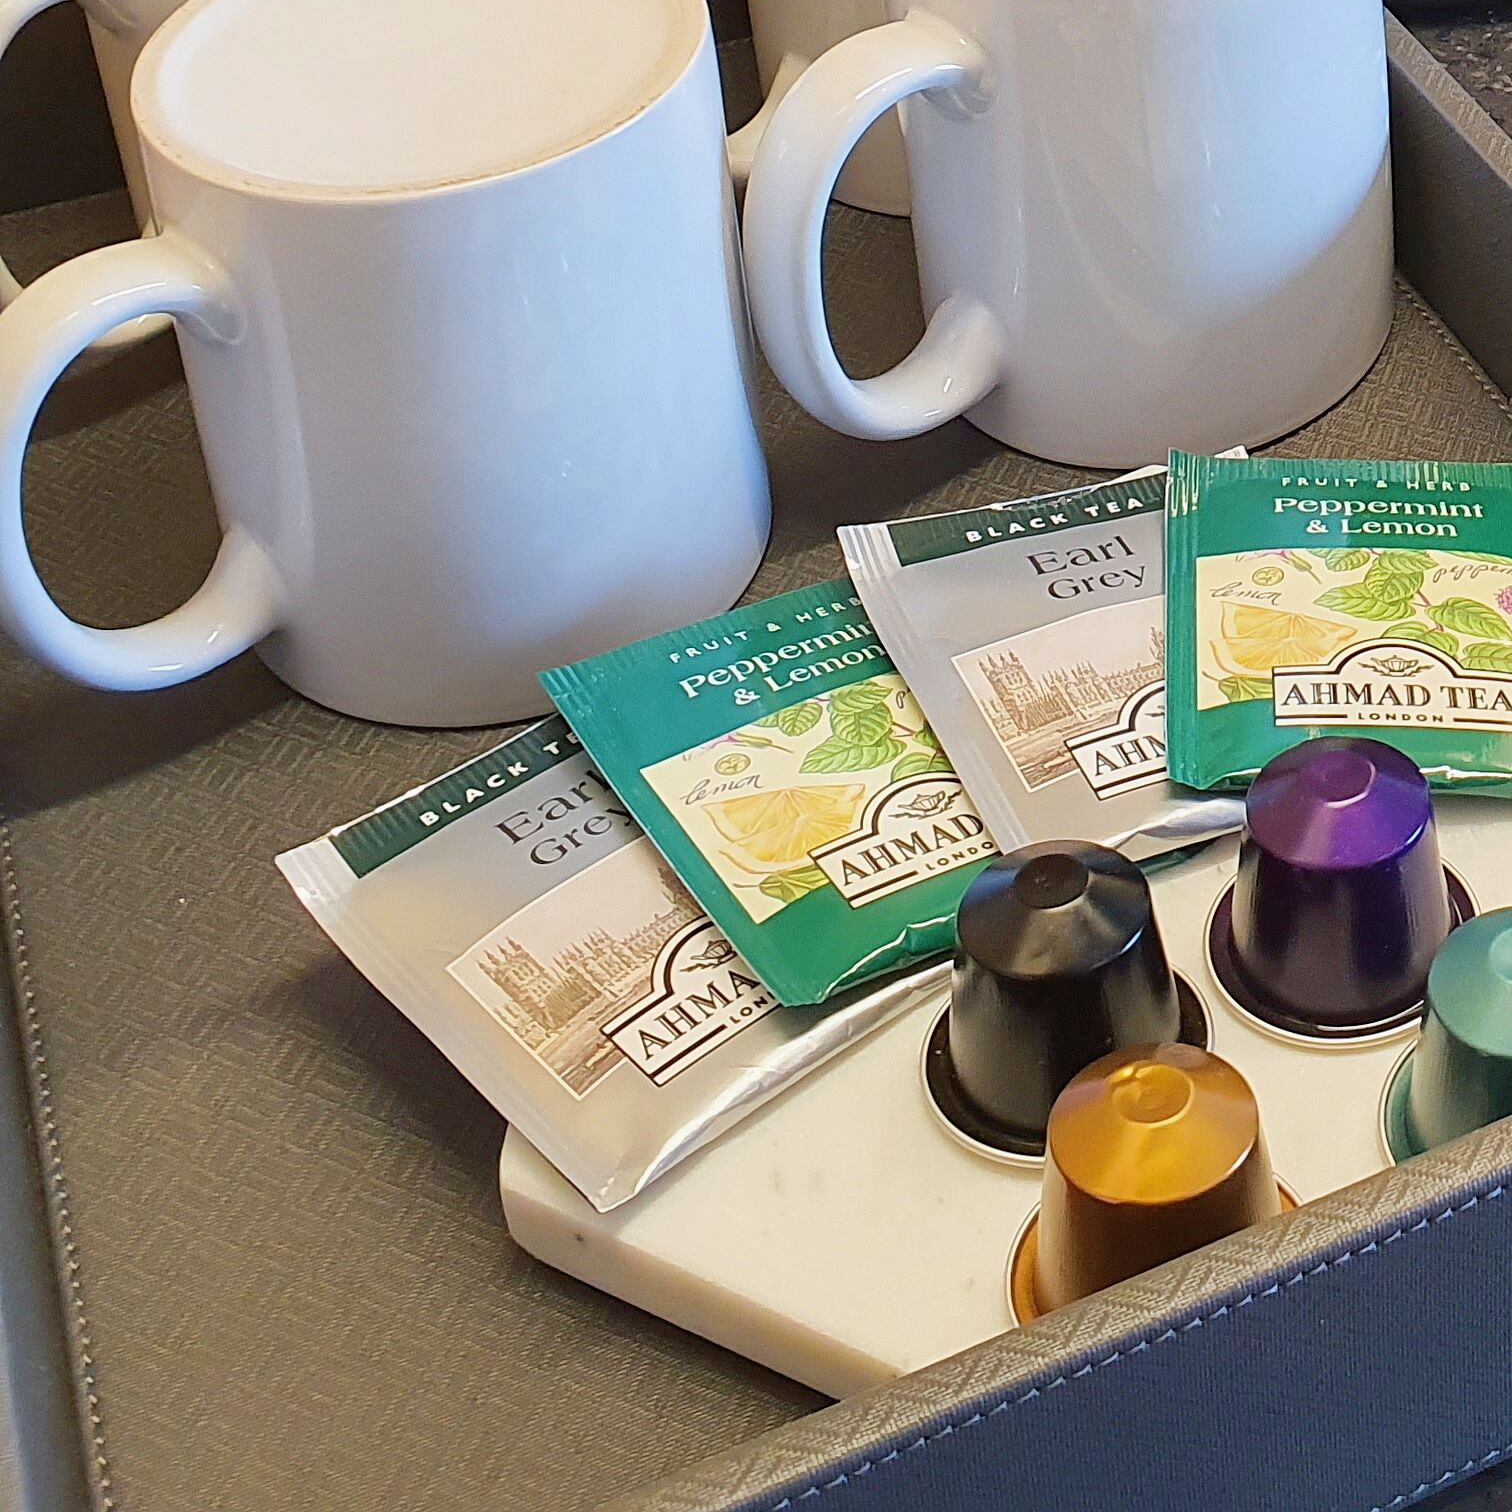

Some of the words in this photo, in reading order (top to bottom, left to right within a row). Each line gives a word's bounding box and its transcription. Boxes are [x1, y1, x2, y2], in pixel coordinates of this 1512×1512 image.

[1281, 476, 1358, 488] FRUIT
[1376, 479, 1388, 488] &
[1406, 480, 1472, 492] HERB
[965, 513, 1069, 543] BLACK
[1084, 497, 1144, 518] TEA
[1273, 497, 1485, 518] Peppermint
[1306, 519, 1329, 534] &
[1341, 518, 1459, 537] Lemon
[1026, 535, 1135, 576] Earl
[1047, 565, 1146, 600] Grey
[1209, 581, 1283, 606] lemon
[669, 631, 749, 664] FRUIT
[766, 622, 782, 633] &
[733, 688, 761, 706] &
[763, 645, 887, 693] Lemon
[1281, 682, 1432, 707] AHMAD
[1358, 712, 1444, 723] LONDON
[419, 761, 529, 826] BLACK
[542, 732, 579, 755] TE
[680, 774, 764, 805] lemon
[841, 813, 984, 886] AHMAD
[925, 841, 994, 871] LONDO
[638, 970, 761, 1061] AHMA
